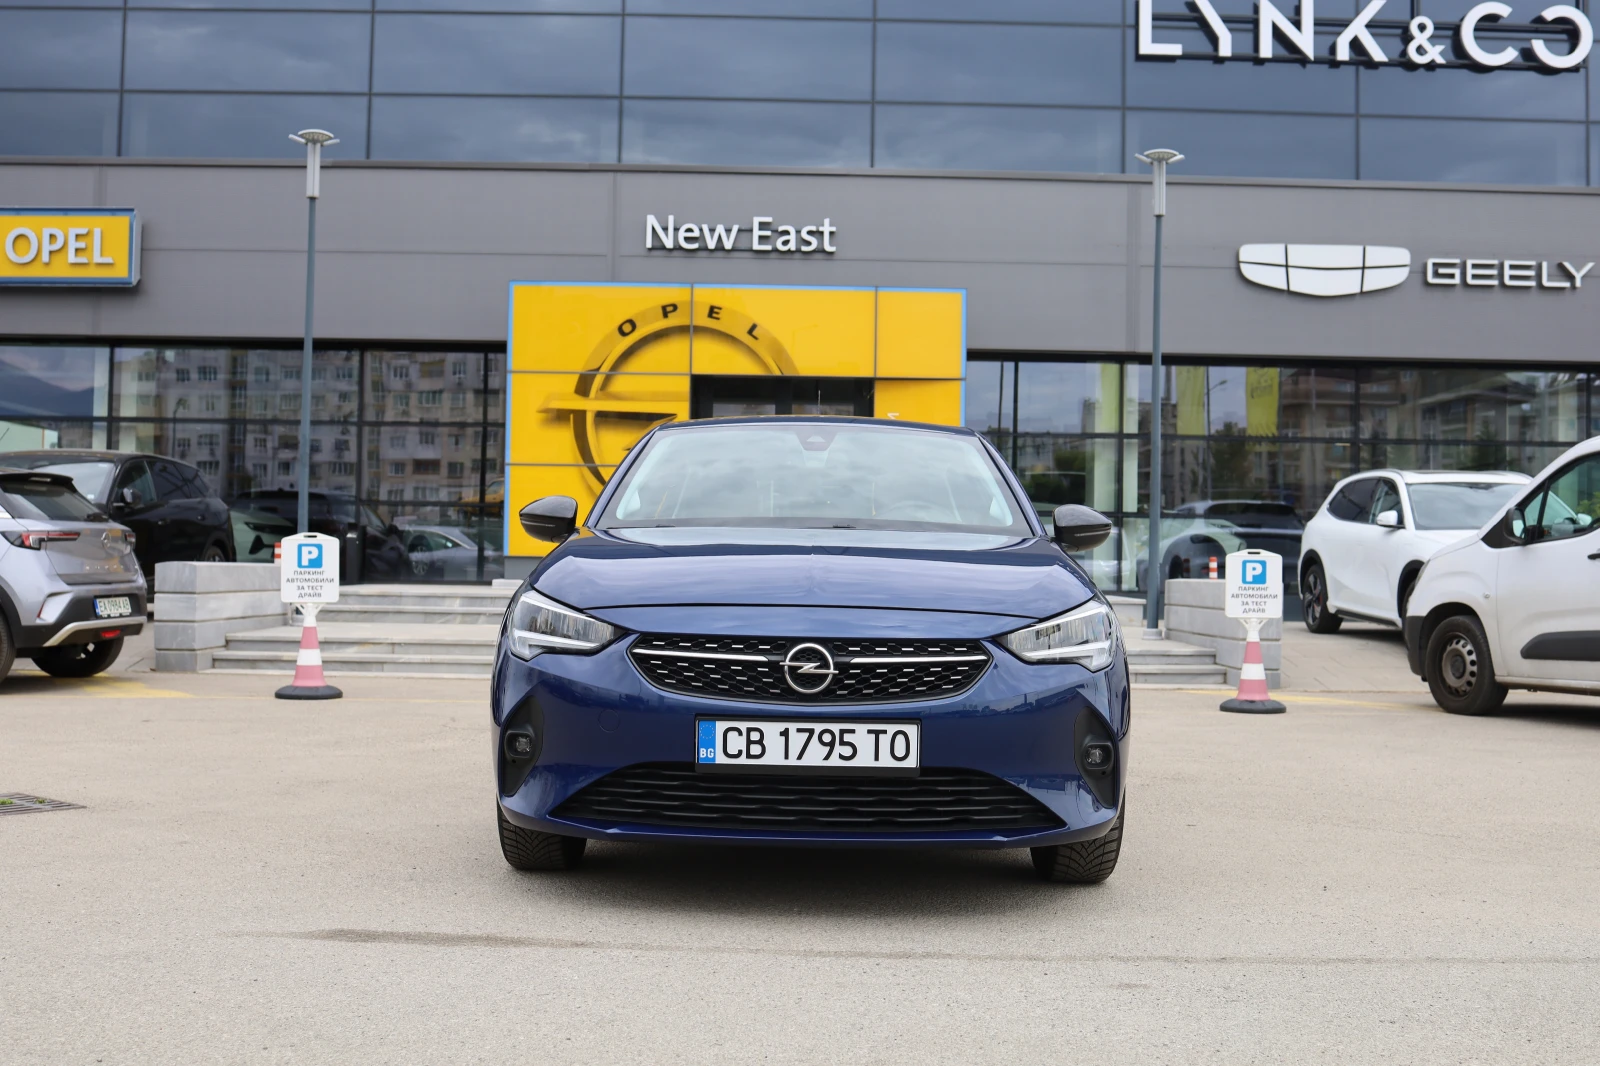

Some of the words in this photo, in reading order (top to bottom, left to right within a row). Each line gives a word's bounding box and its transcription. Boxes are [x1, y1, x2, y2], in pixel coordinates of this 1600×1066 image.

[4, 226, 115, 265] OPEL
[645, 214, 740, 250] New
[752, 216, 837, 252] East
[1426, 257, 1596, 288] GEELY
[617, 303, 760, 341] OPEL
[301, 546, 319, 567] P
[1245, 562, 1263, 582] P
[700, 748, 714, 758] BG
[722, 726, 766, 759] CB
[779, 727, 858, 761] 1795
